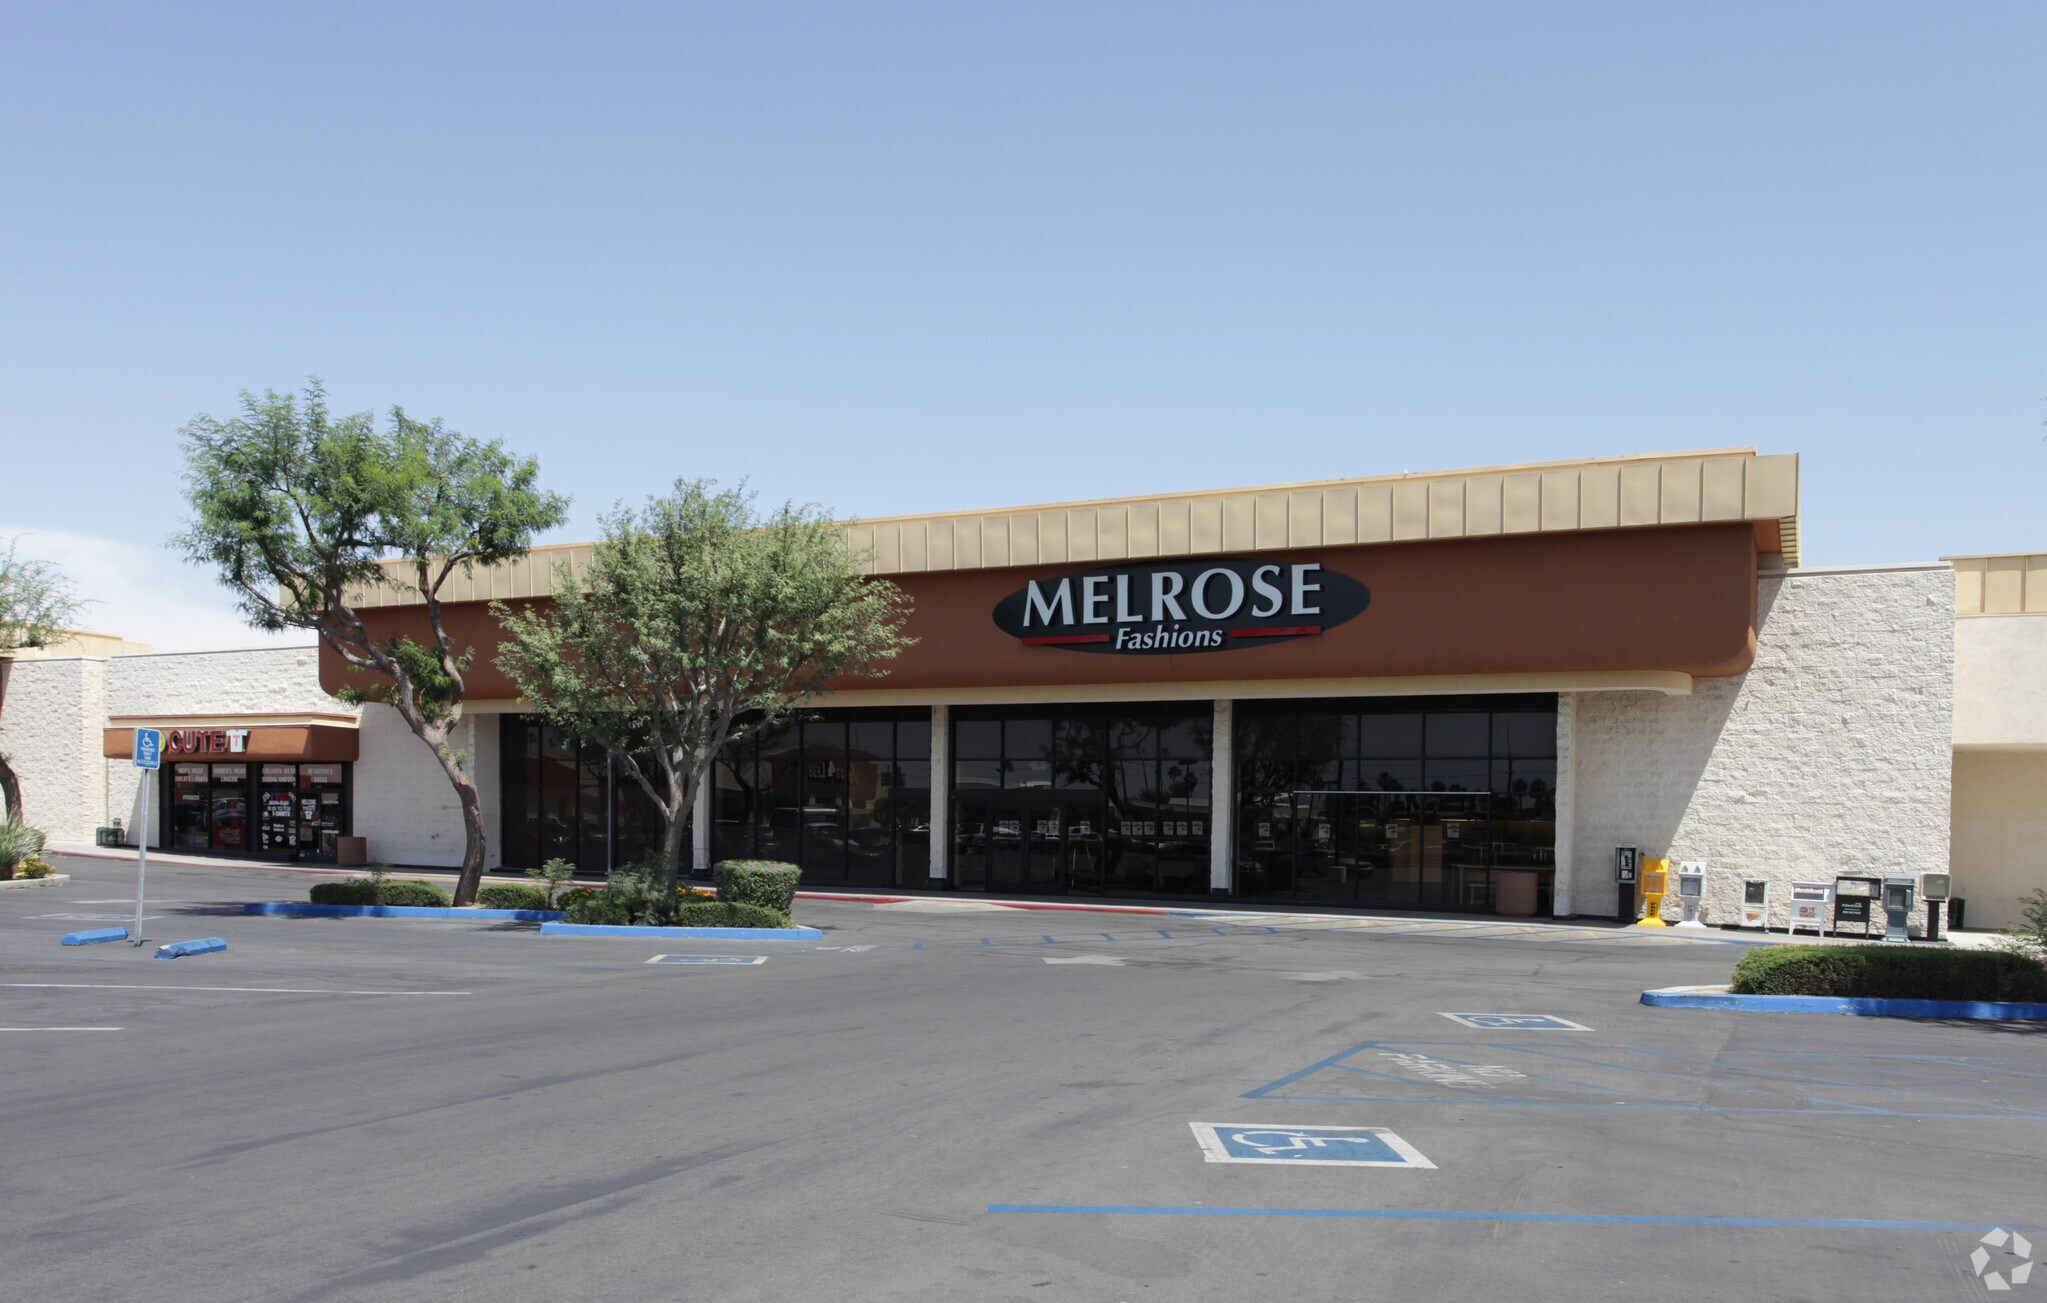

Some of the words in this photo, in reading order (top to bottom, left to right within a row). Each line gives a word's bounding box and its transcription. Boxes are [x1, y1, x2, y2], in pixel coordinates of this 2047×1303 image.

[1023, 563, 1321, 627] MELROSE
[1115, 624, 1223, 650] Fashions
[168, 730, 227, 753] CUTE
